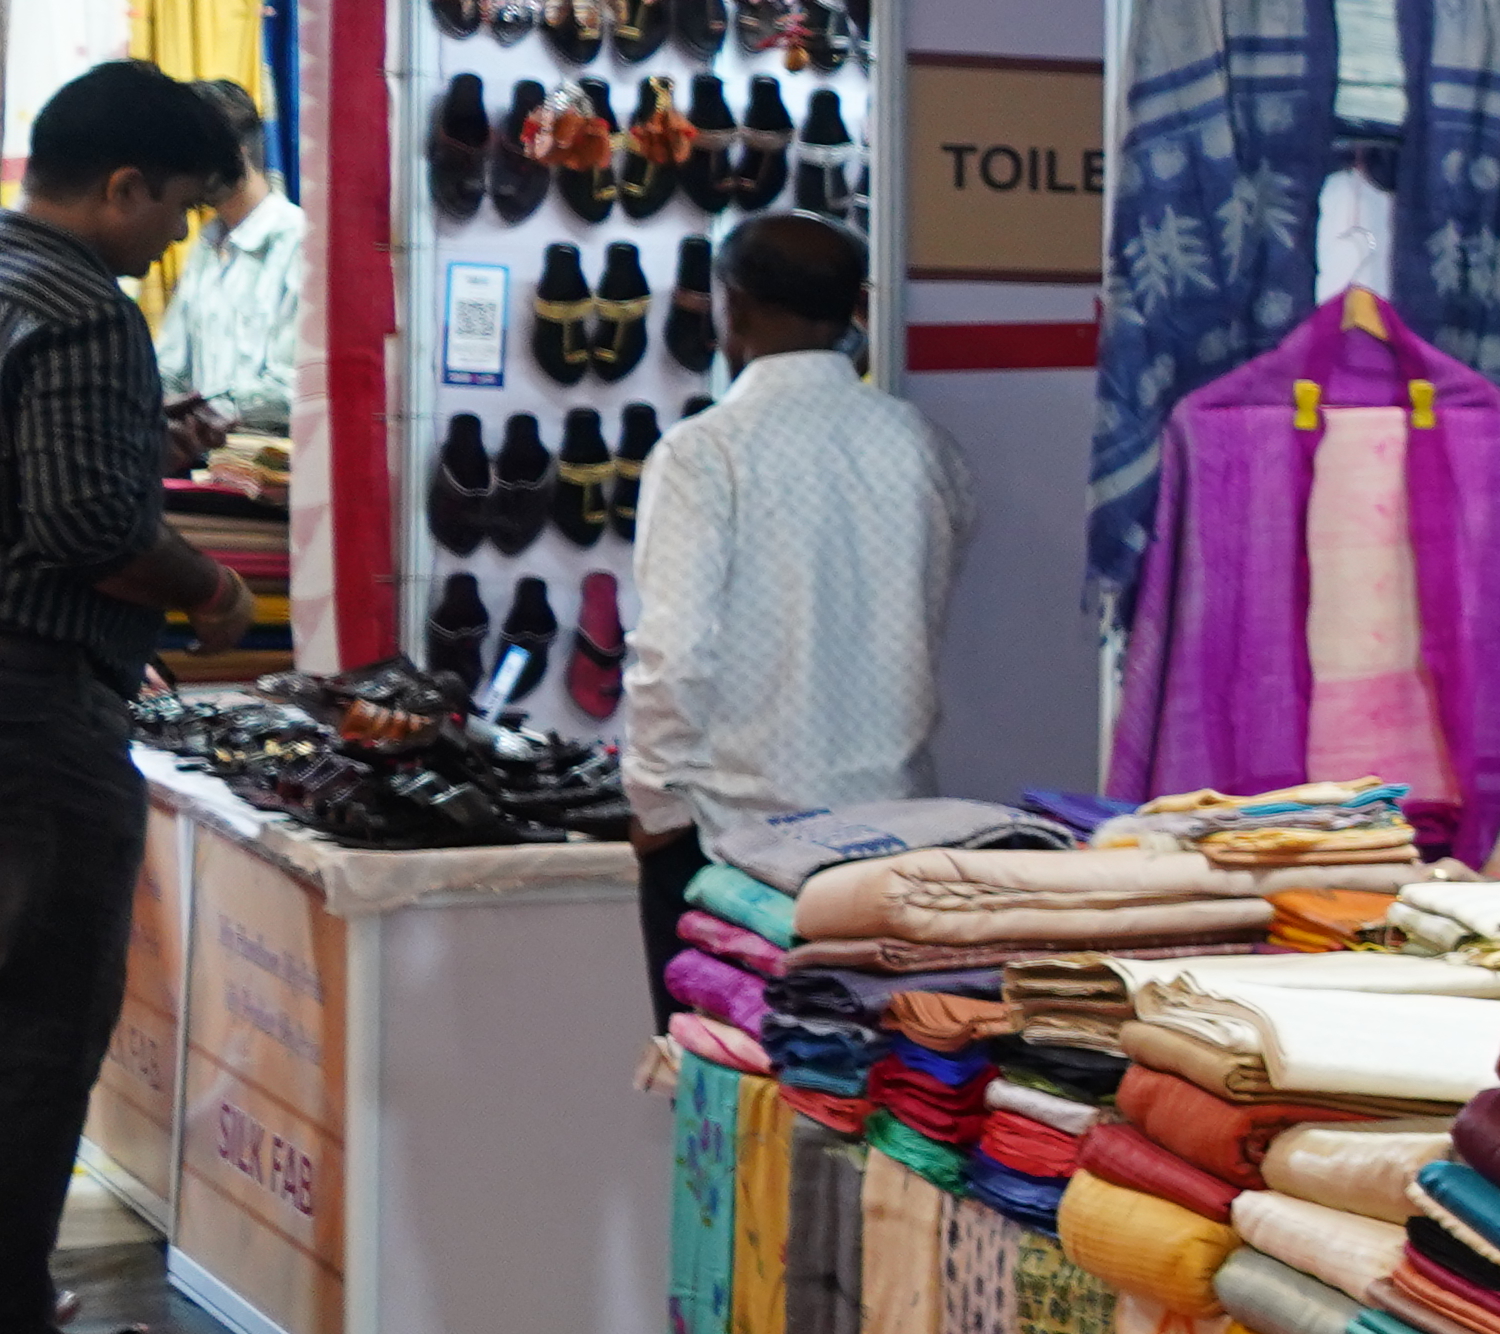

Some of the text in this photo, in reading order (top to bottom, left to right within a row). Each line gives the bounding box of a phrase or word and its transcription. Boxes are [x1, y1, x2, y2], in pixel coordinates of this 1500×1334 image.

[939, 140, 1104, 195] TOILE
[216, 1100, 315, 1218] SILK FAB
